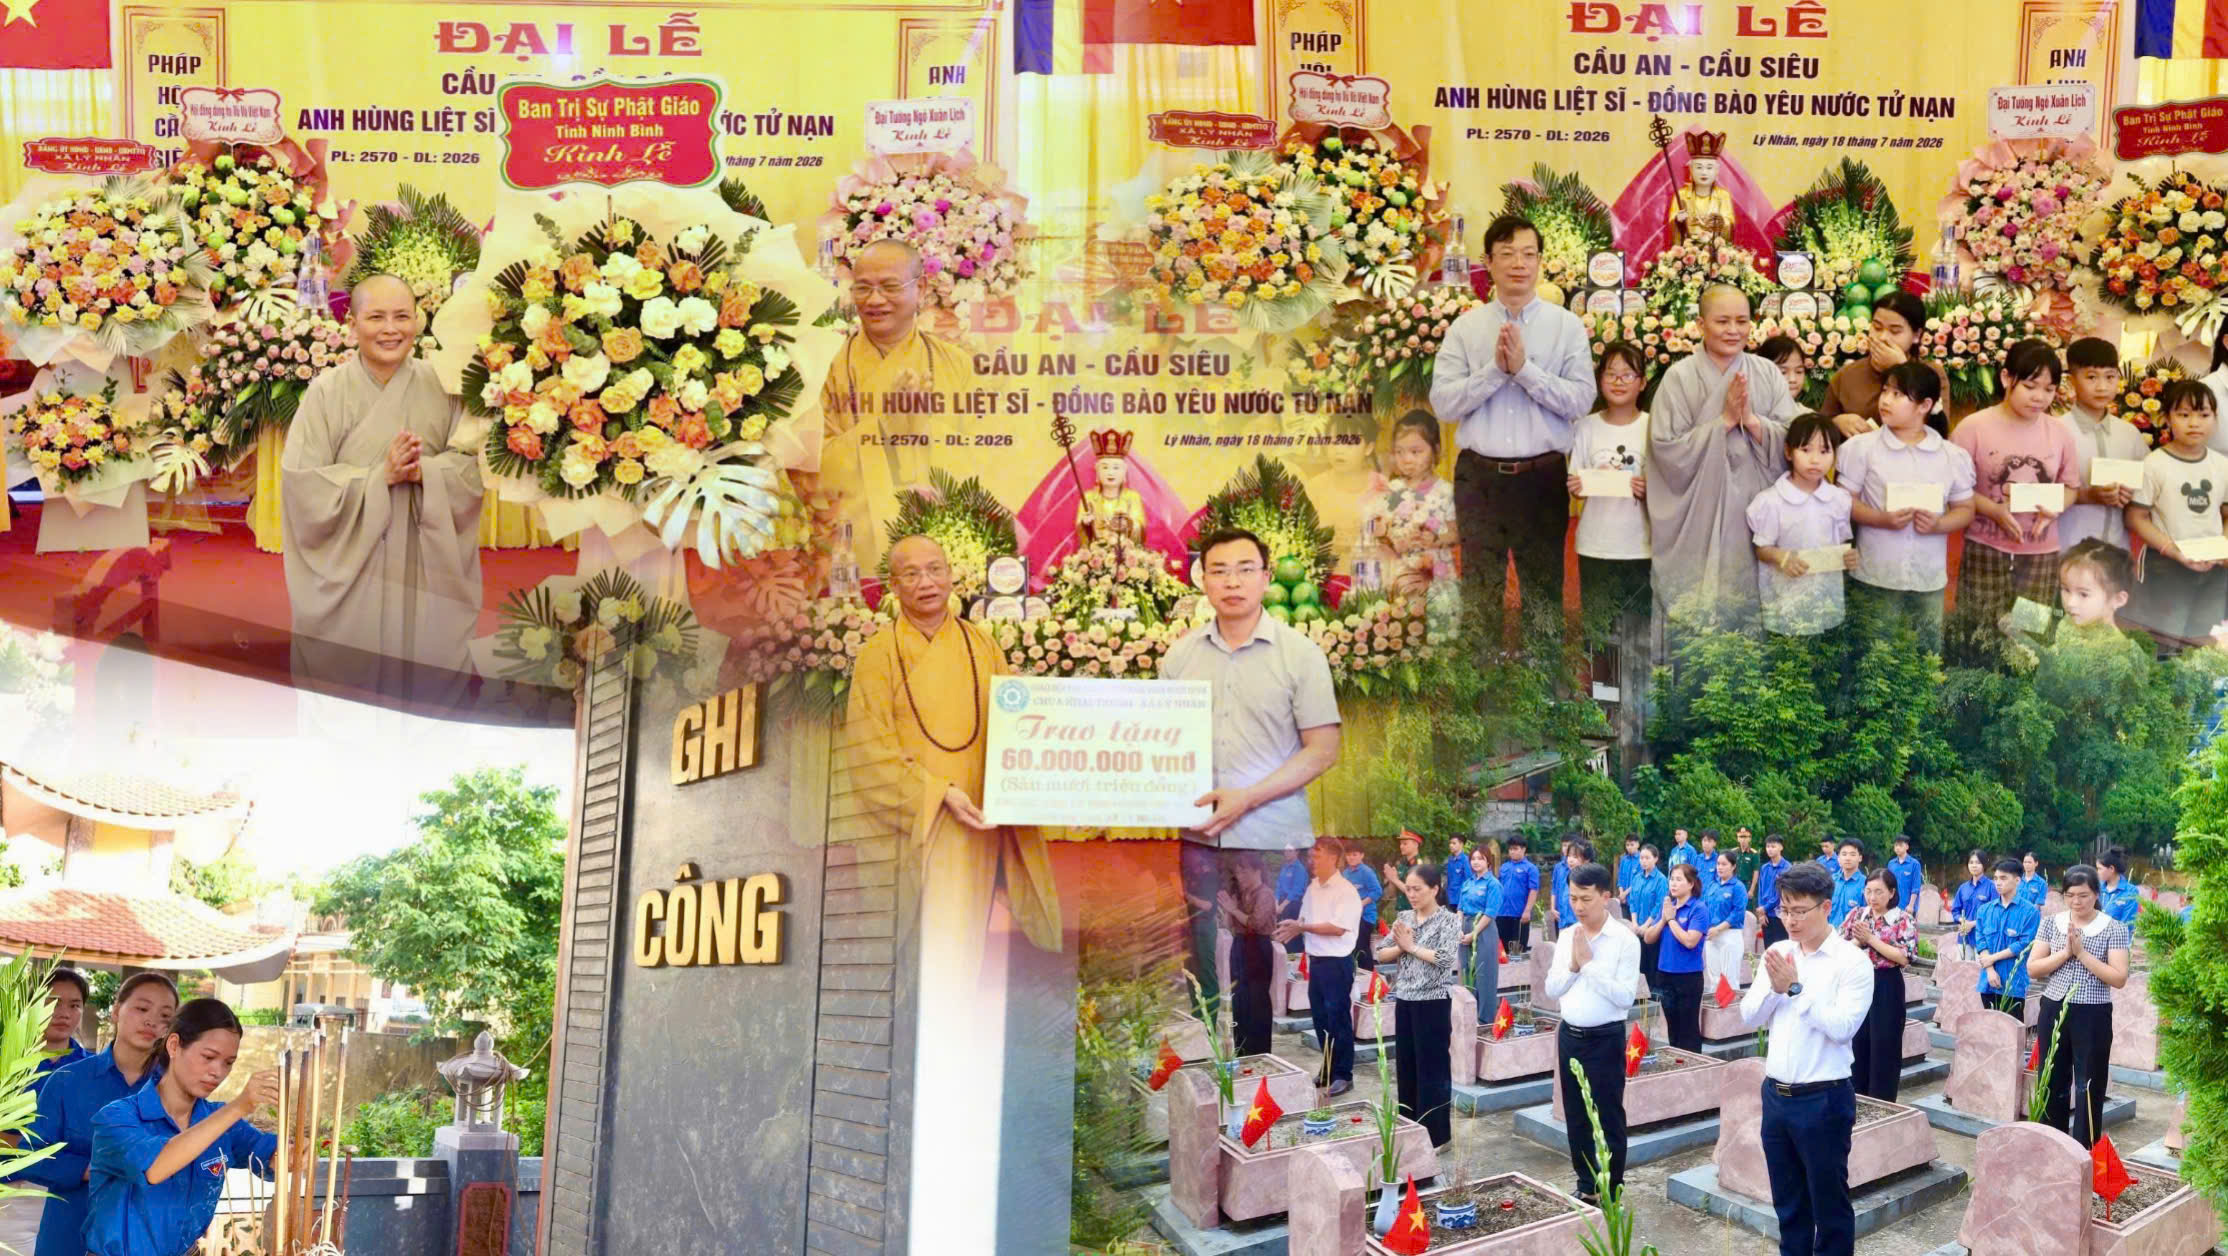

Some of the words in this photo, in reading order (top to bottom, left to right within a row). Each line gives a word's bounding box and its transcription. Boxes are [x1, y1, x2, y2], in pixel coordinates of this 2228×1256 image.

[1566, 2, 1703, 42] ĐẠI
[433, 21, 574, 62] ĐẠI
[608, 12, 702, 57] LỄ
[1290, 30, 1342, 54] PHÁP
[148, 53, 201, 75] PHÁP
[1574, 46, 1626, 75] CẦU
[1635, 54, 1671, 75] AN
[1699, 49, 1751, 77] CẦU
[1760, 53, 1819, 79] SIÊU
[2050, 49, 2086, 68] ANH
[442, 65, 496, 95] CẦU
[929, 65, 966, 85] ANH
[518, 99, 552, 119] Ban
[556, 98, 580, 121] Trị
[586, 97, 608, 121] Sự
[613, 97, 655, 121] Phật
[661, 96, 701, 116] Giáo
[1434, 86, 1479, 109] ANH
[1487, 84, 1547, 110] HÙNG
[1554, 85, 1598, 115] LIỆT
[1605, 87, 1627, 112] SĨ
[1647, 85, 1707, 114] ĐỒNG
[1714, 89, 1757, 115] BÀO
[1764, 90, 1804, 116] YÊU
[1811, 90, 1870, 117] NƯỚC
[1877, 89, 1905, 118] TỬ
[1909, 96, 1955, 123] NẠN
[155, 113, 179, 138] CẦ
[298, 109, 345, 131] ANH
[352, 105, 414, 133] HÙNG
[422, 106, 467, 137] LIỆT
[754, 108, 782, 135] TỬ
[788, 114, 834, 141] NẠN
[592, 123, 625, 138] Ninh
[630, 122, 664, 138] Bình
[1467, 128, 1489, 140] PL:
[1494, 128, 1531, 140] 2570
[1573, 130, 1610, 142] 2026
[1753, 134, 1767, 148] Lý
[1802, 135, 1829, 149] ngày
[1832, 136, 1846, 147] 18
[1847, 135, 1877, 149] tháng
[1881, 136, 1888, 147] 7
[1889, 136, 1914, 148] năm
[1916, 137, 1944, 148] 2026
[331, 150, 355, 163] PL:
[360, 151, 398, 163] 2570
[442, 152, 480, 164] 2026
[759, 156, 766, 166] 7
[768, 156, 793, 167] năm
[795, 156, 823, 167] 2026
[973, 346, 1028, 376] CẦU
[1038, 353, 1076, 376] AN
[1105, 347, 1159, 377] CẦU
[1169, 350, 1230, 377] SIÊU
[882, 388, 945, 415] HÙNG
[953, 388, 999, 418] LIỆT
[1007, 388, 1029, 414] SĨ
[1052, 384, 1114, 415] ĐỒNG
[1122, 387, 1167, 414] BÀO
[1175, 388, 1216, 415] YÊU
[1224, 389, 1284, 415] NƯỚC
[860, 434, 885, 446] PL:
[890, 434, 929, 446] 2570
[975, 434, 1013, 446] 2026
[1164, 433, 1177, 447] Lý
[1215, 434, 1243, 447] ngày
[1247, 434, 1260, 445] 18
[1297, 434, 1304, 445] 7
[1335, 434, 1362, 446] 2026
[671, 681, 761, 787] GHI
[1016, 714, 1095, 741] Trao
[1108, 718, 1182, 748] tặng
[1001, 748, 1143, 773] 60.000.000
[633, 863, 784, 967] CÔNG
